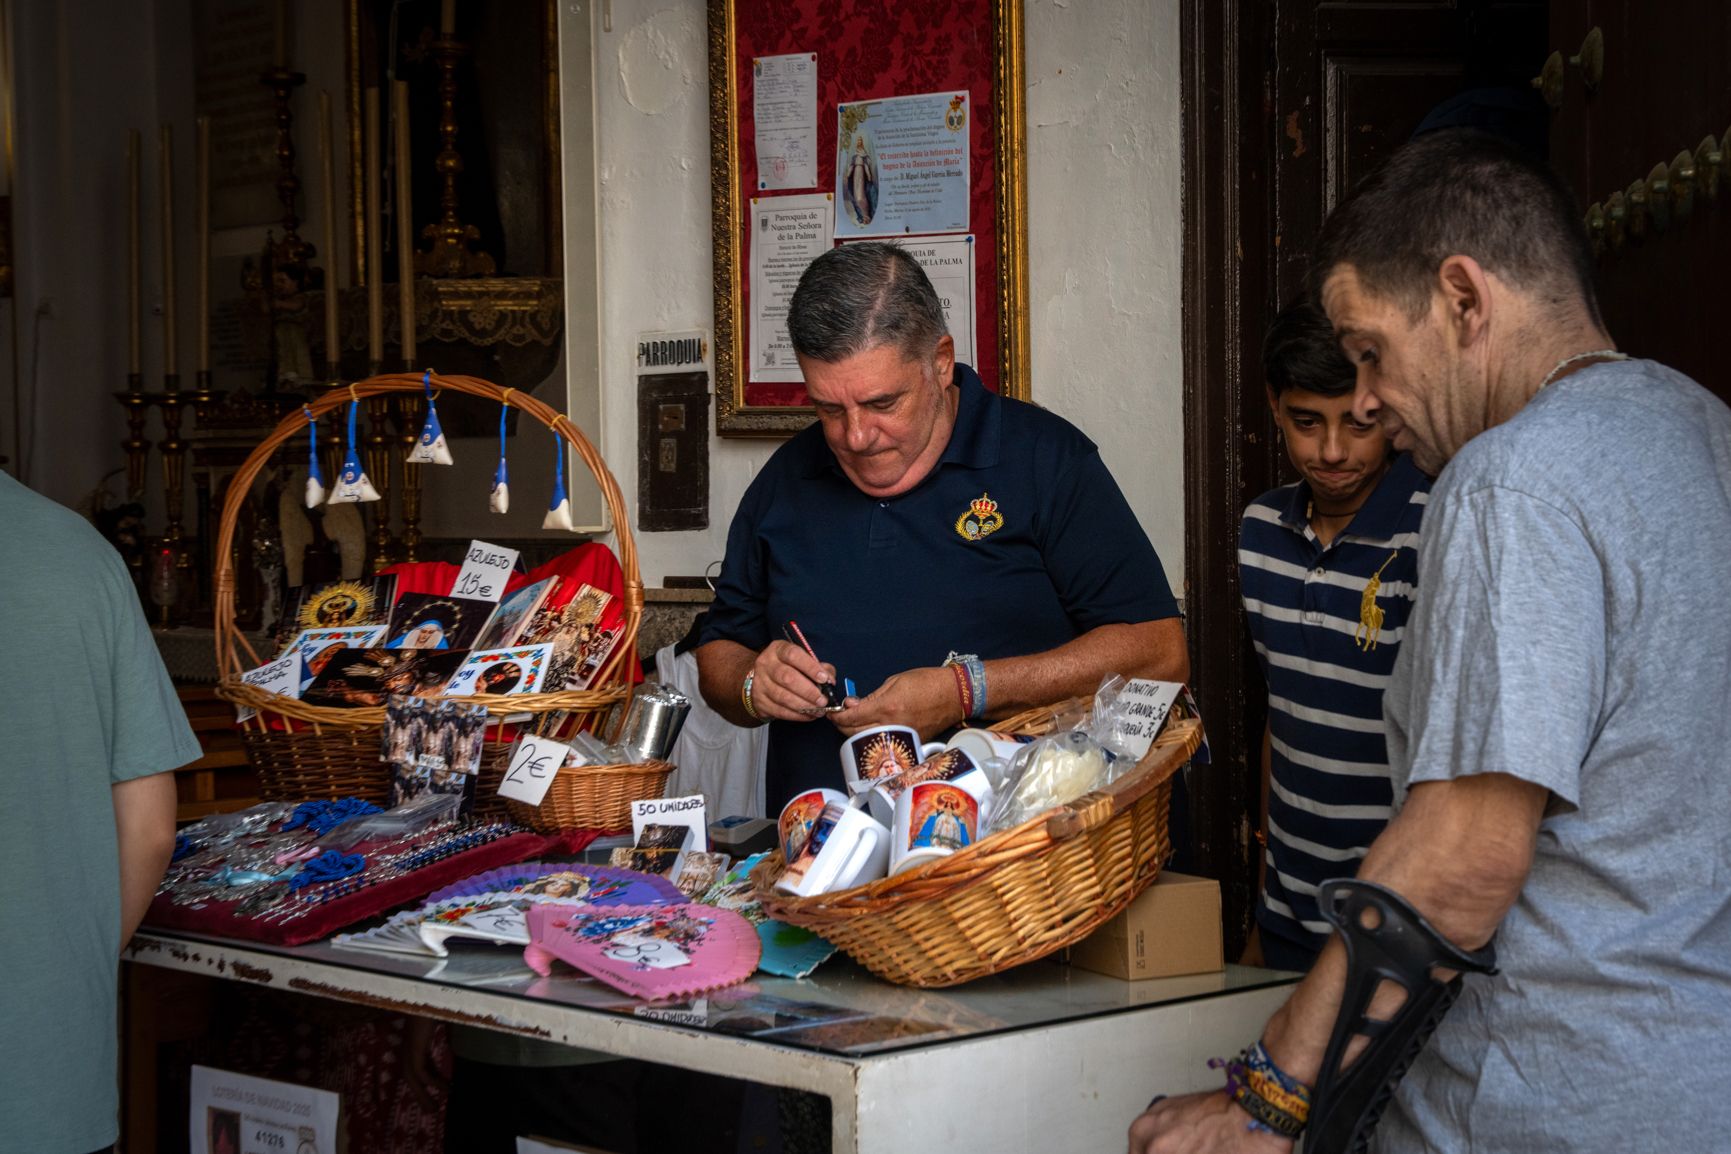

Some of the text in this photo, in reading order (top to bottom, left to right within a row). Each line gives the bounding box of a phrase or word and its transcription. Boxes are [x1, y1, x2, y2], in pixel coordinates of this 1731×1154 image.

[775, 212, 818, 222] Parroquia de
[771, 222, 822, 231] Nuestra Señora
[777, 231, 817, 241] de la Palma
[927, 249, 936, 257] DE
[939, 257, 963, 266] PALMA
[638, 337, 704, 368] PARROQUIA
[468, 548, 510, 570] AZULEJO
[456, 572, 492, 597] 15€
[458, 669, 476, 681] oy
[1128, 702, 1156, 718] GRANDE
[506, 743, 552, 784] 2€
[637, 803, 657, 816] 50
